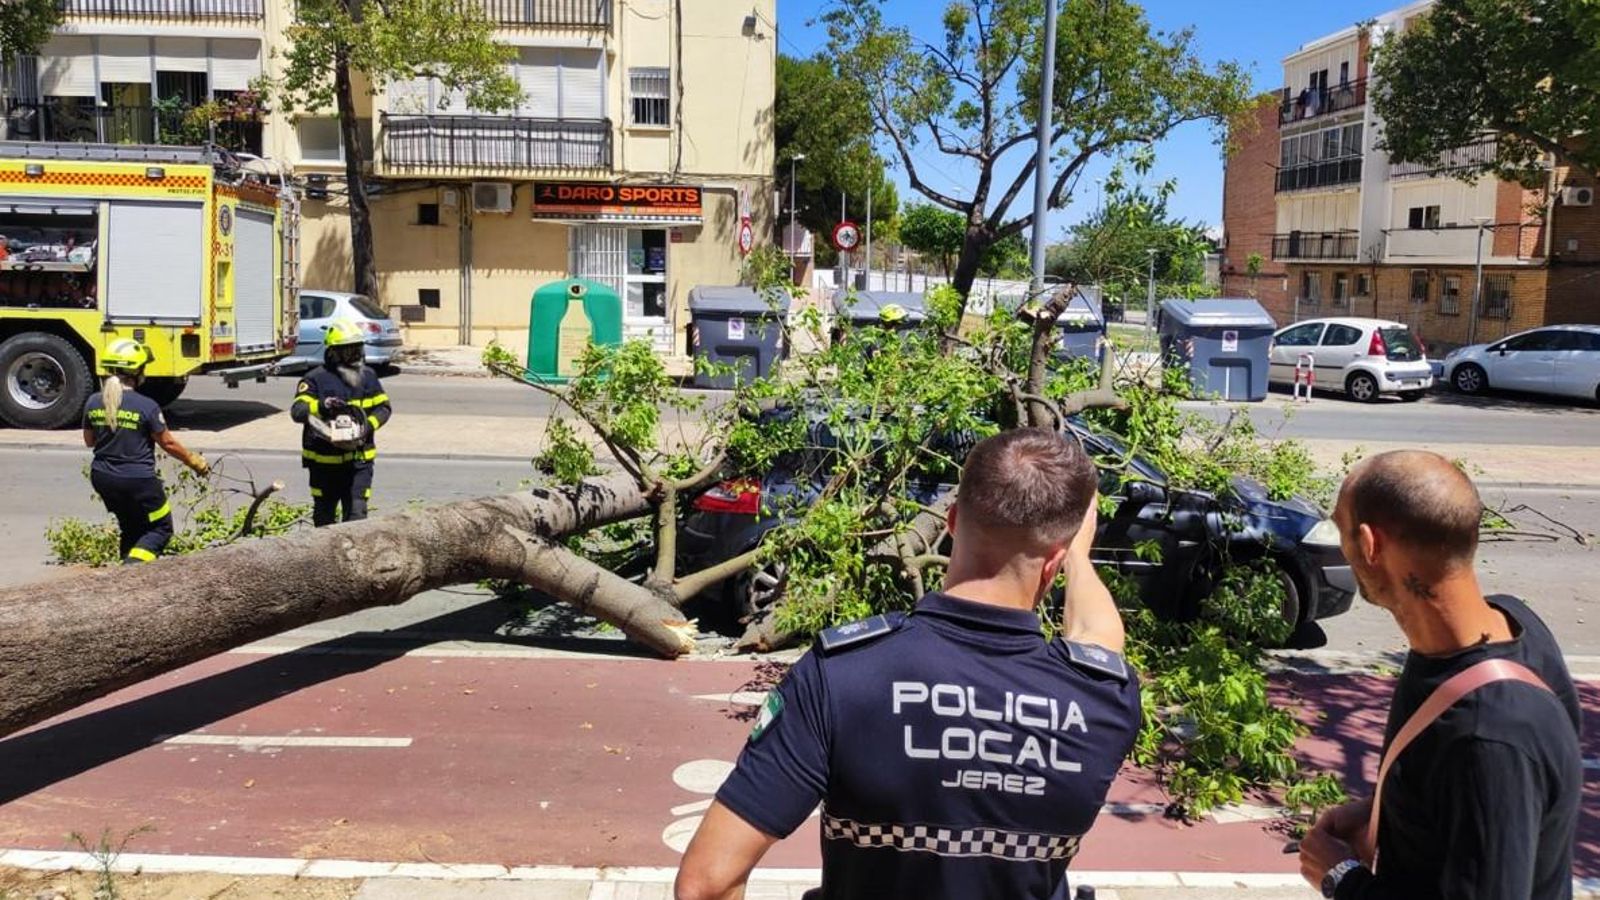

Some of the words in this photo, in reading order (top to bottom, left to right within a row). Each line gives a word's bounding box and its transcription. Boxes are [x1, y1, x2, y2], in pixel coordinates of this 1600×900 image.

[557, 186, 614, 201] DARO
[619, 187, 699, 202] SPORTS
[88, 409, 140, 421] OMROS
[892, 681, 1088, 733] POLICIA
[904, 724, 1082, 773] LOCAL
[941, 769, 1047, 796] JEREZ
